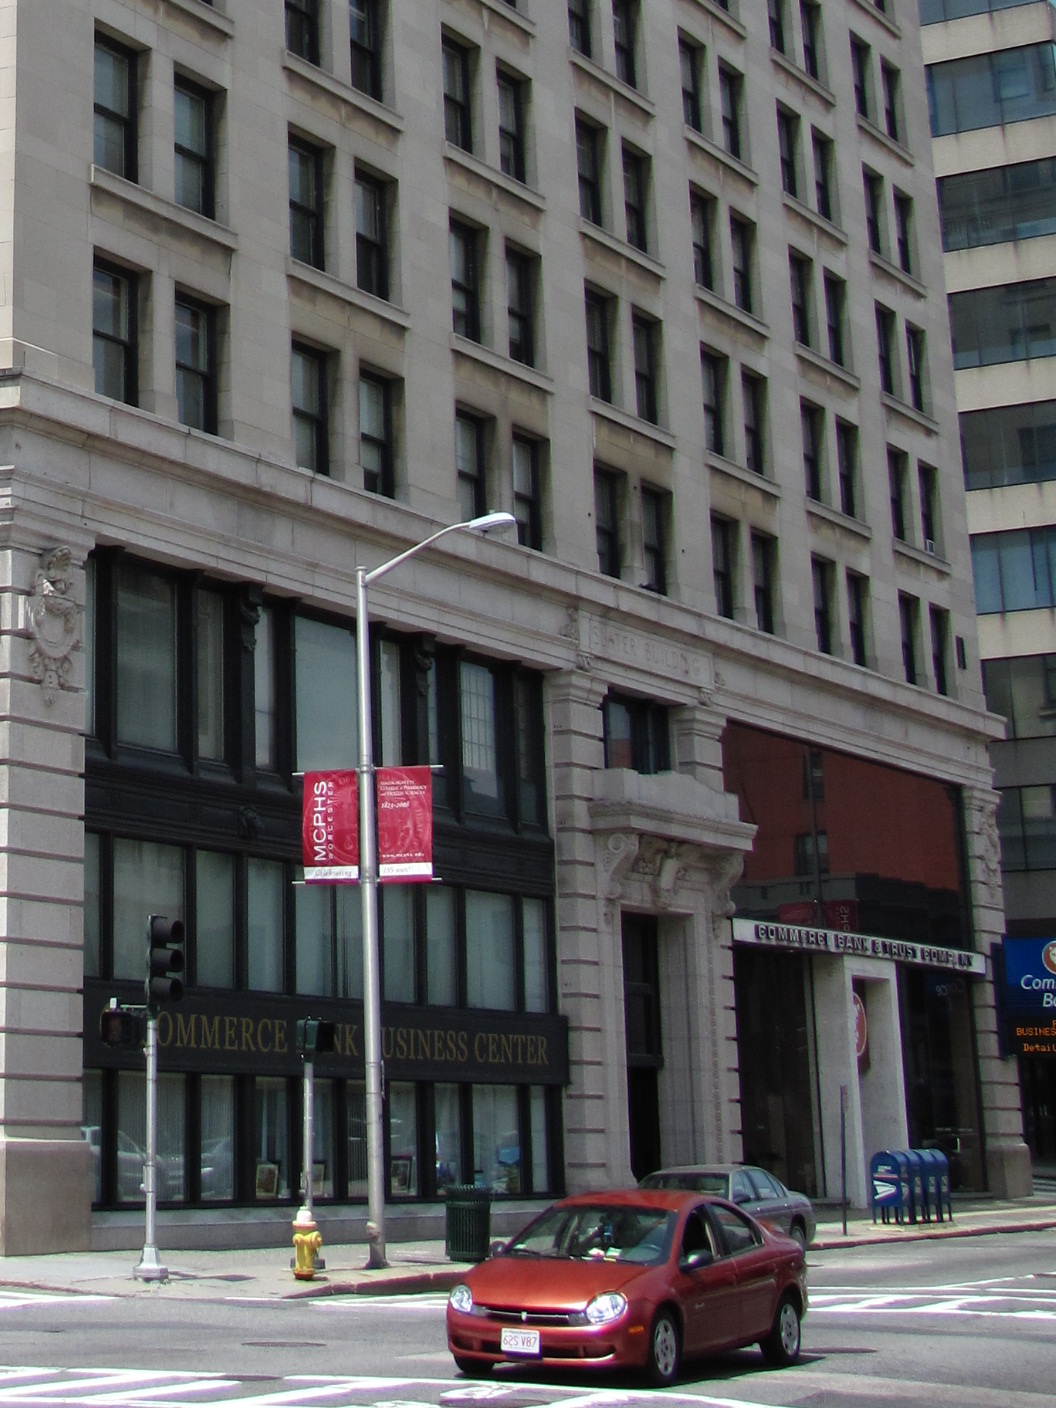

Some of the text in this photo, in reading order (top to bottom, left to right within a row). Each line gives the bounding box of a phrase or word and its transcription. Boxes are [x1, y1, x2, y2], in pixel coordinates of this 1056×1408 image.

[313, 781, 327, 861] MCPHS
[755, 923, 832, 948] COMMERCE
[834, 933, 870, 952] BANK
[882, 940, 919, 960] TRUST
[1020, 974, 1056, 990] Com
[100, 1002, 288, 1053] OMMERCE
[380, 1026, 469, 1062] USINESS
[474, 1032, 550, 1066] CENTER
